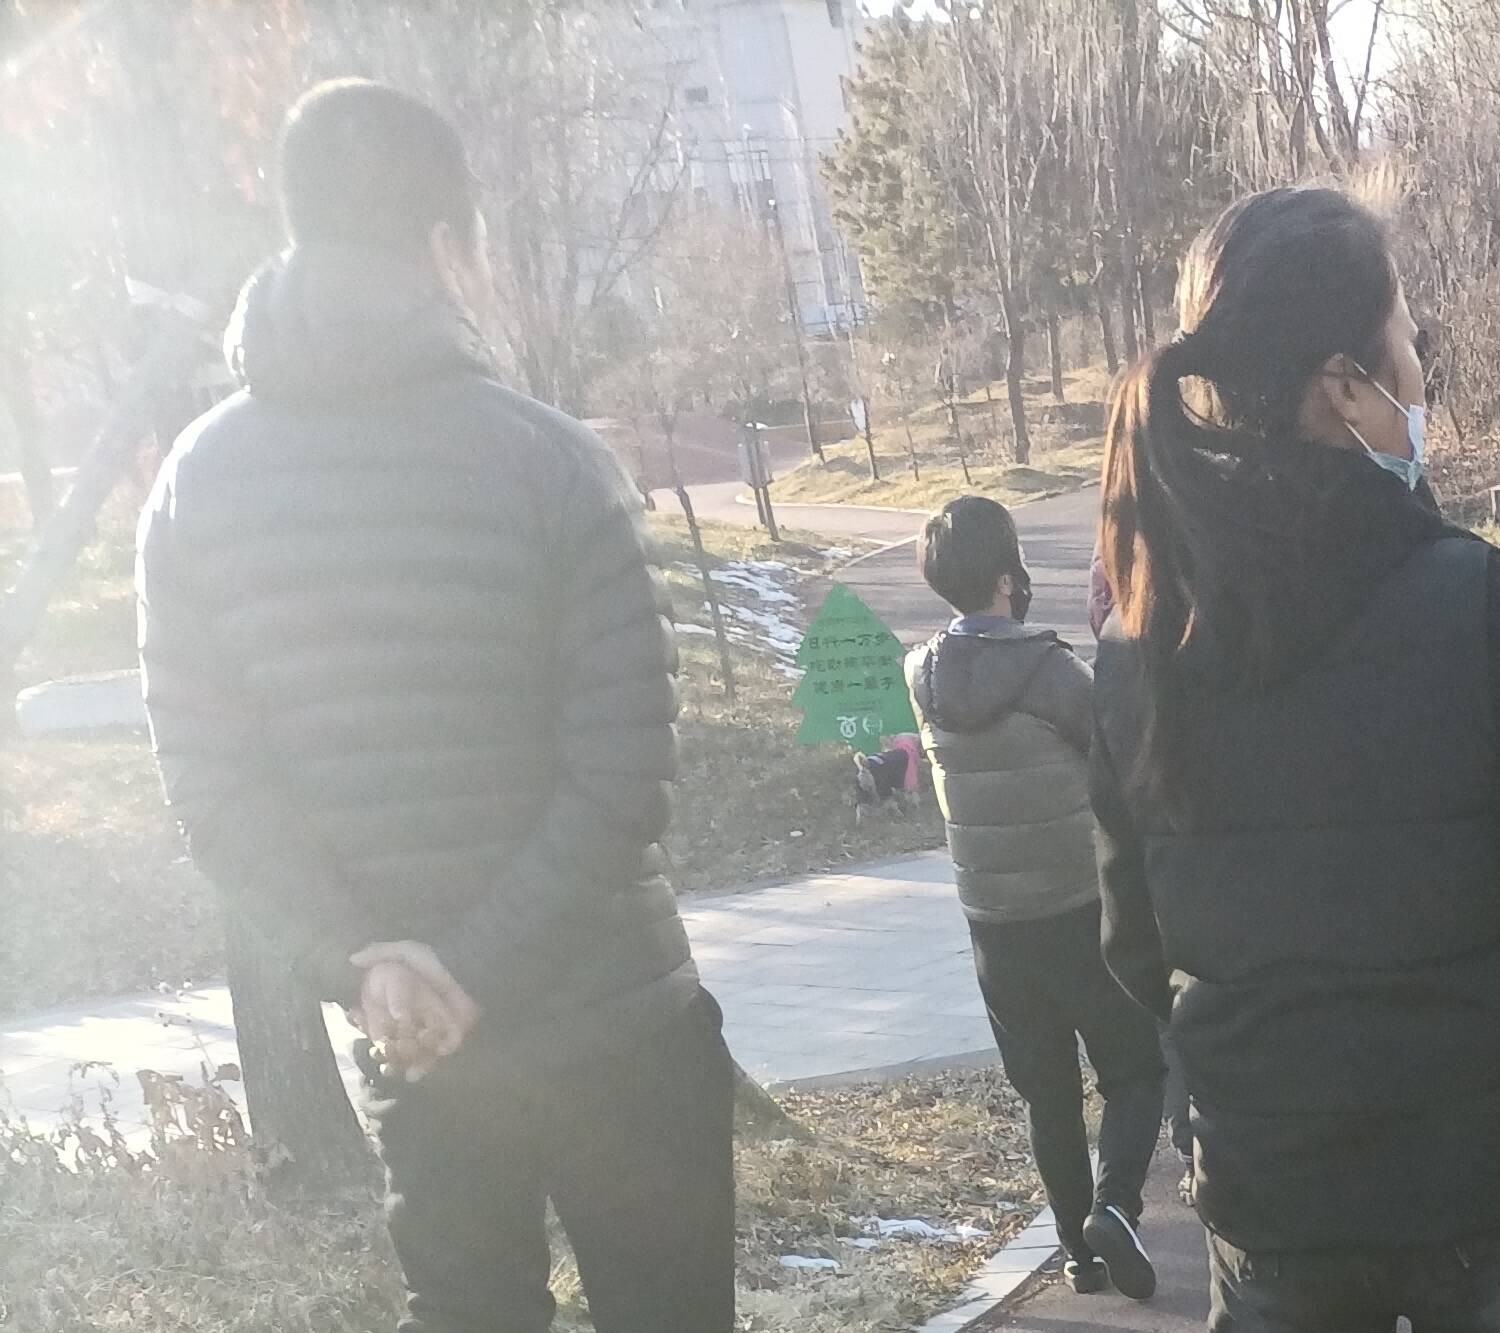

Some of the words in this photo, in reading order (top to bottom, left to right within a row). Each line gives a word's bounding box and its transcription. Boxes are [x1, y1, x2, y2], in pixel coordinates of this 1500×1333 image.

[808, 632, 889, 649] 日行一万步
